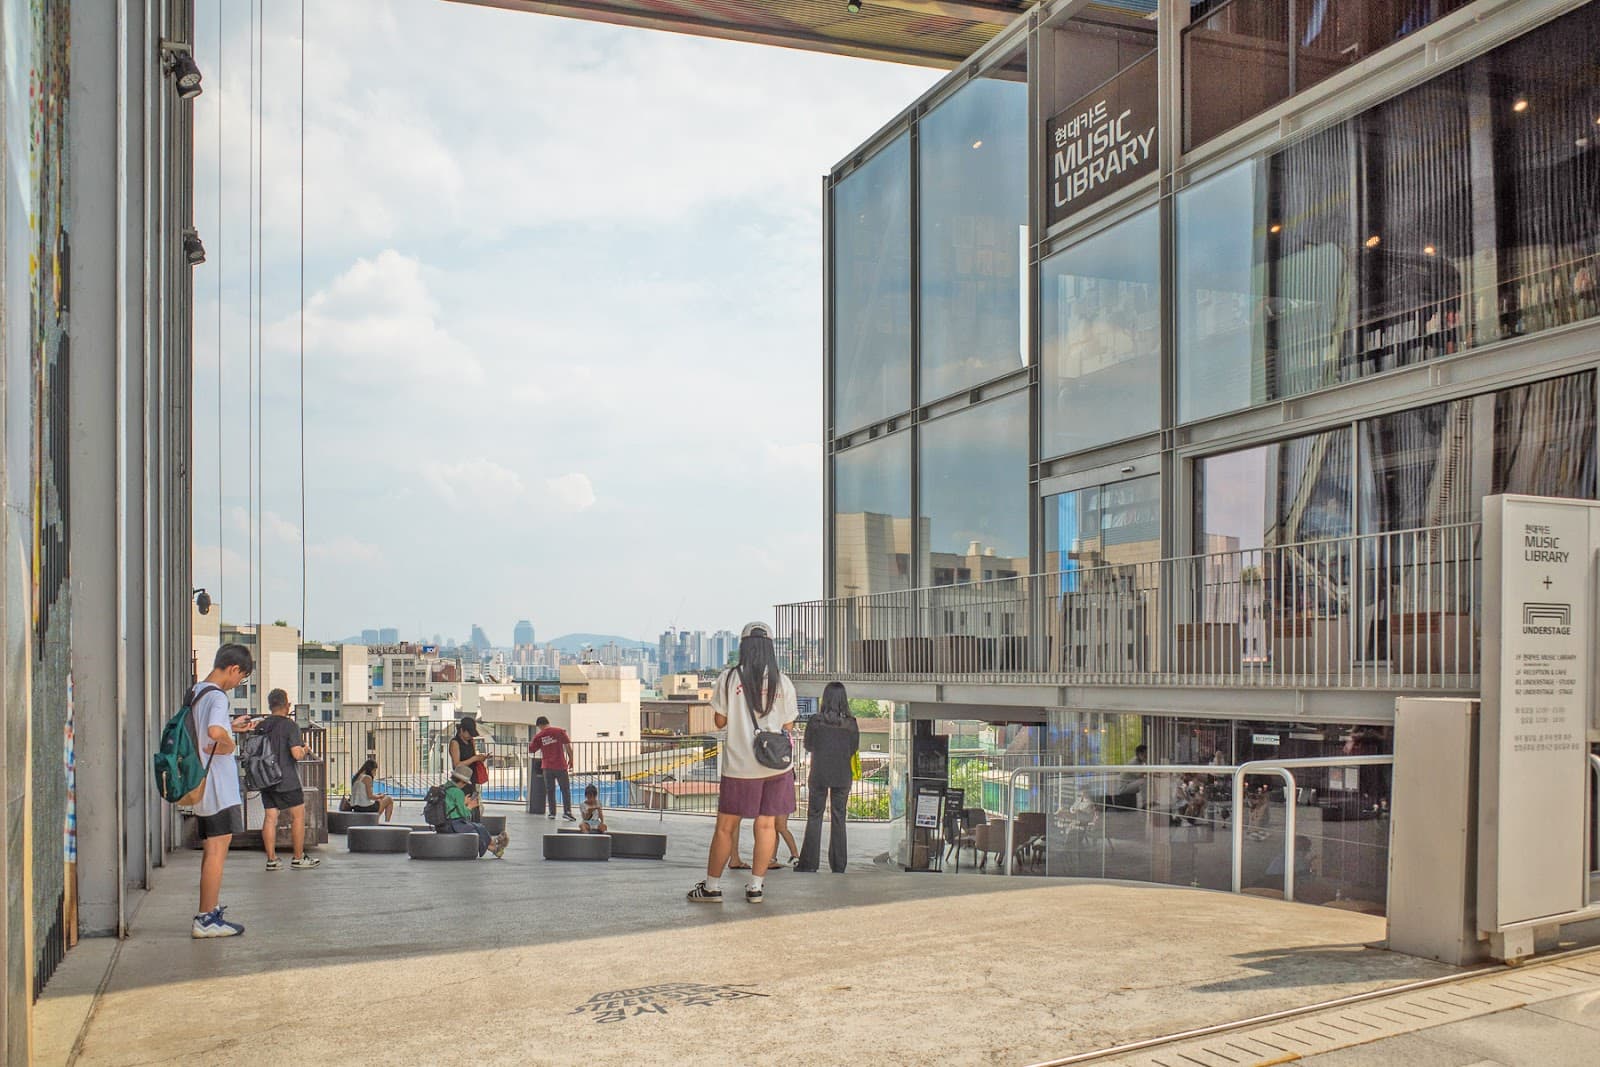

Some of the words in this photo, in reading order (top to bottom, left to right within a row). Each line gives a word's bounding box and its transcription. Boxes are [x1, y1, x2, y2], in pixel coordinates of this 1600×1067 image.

[1055, 100, 1107, 148] 현대카드
[1055, 109, 1131, 179] MUSIC
[1055, 126, 1156, 207] LIBRARY
[1525, 536, 1560, 549] MUSIC
[1525, 550, 1570, 563] LIBRARY
[1523, 626, 1571, 635] UNDERSTAGE
[568, 996, 654, 1015] STEEP
[592, 1003, 668, 1024] 경사
